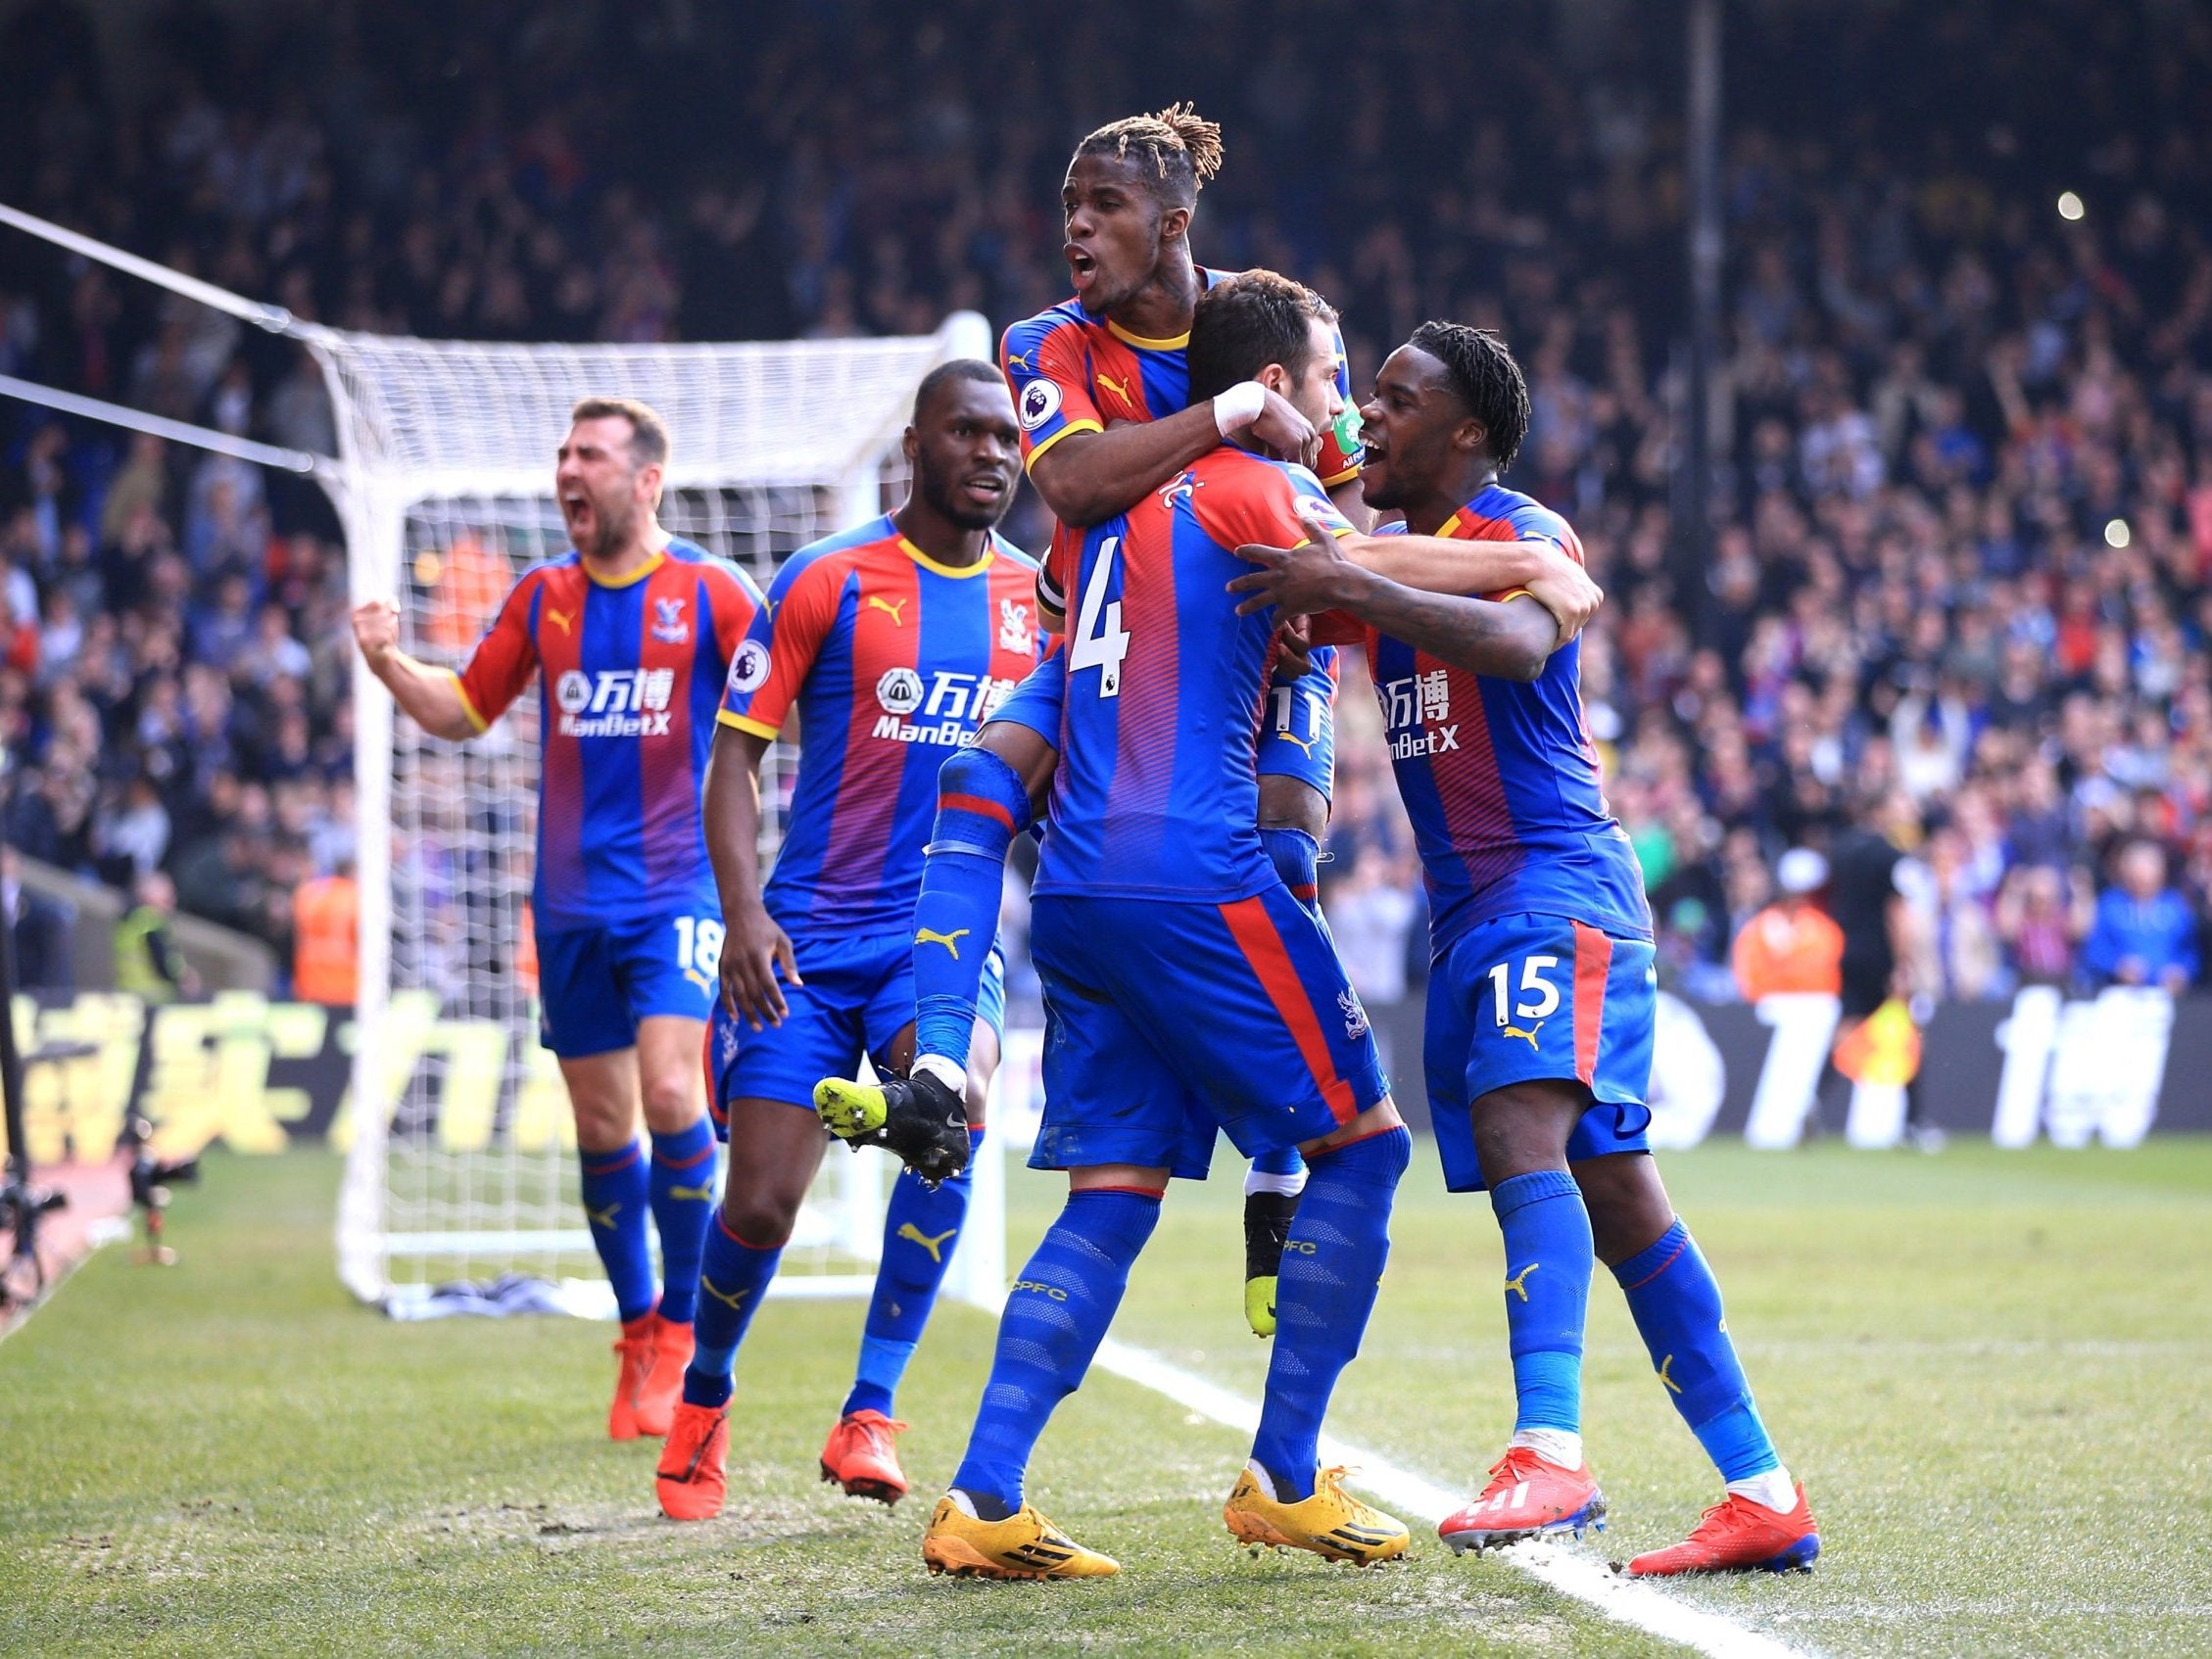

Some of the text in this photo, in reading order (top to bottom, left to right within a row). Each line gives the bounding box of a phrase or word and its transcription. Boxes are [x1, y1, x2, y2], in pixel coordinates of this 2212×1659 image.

[1069, 537, 1130, 698] 4
[591, 668, 675, 713] 万博
[1271, 687, 1321, 742] 11
[1385, 669, 1450, 730] 万博
[558, 712, 672, 737] ManBetX
[673, 915, 726, 978] 18
[1488, 956, 1560, 1027] 15
